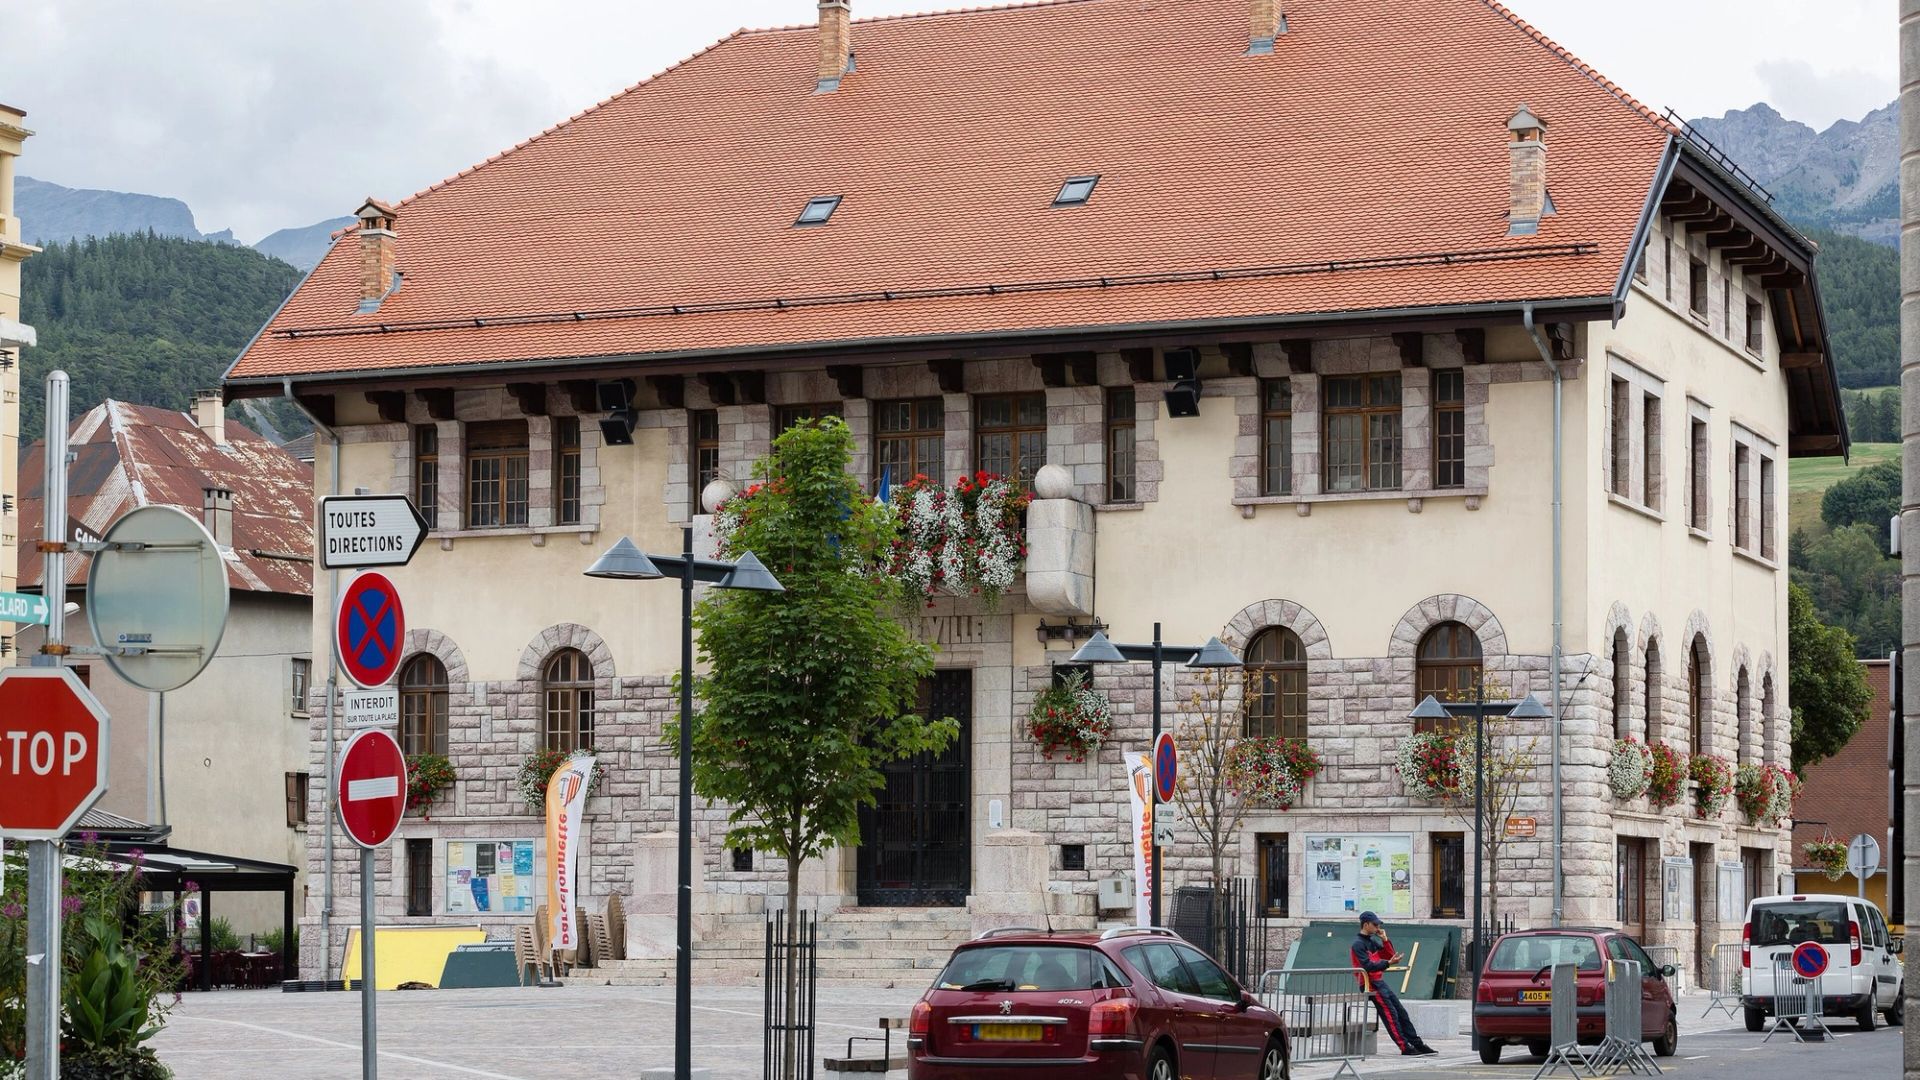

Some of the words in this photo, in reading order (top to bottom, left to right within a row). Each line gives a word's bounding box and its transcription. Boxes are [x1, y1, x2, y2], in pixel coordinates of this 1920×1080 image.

[329, 511, 376, 529] TOUTES
[329, 535, 403, 554] DIRECTIONS
[350, 696, 394, 710] INTERDIT
[347, 715, 358, 723] SUR
[358, 714, 374, 722] TOUTE
[374, 713, 382, 722] LA
[382, 712, 397, 721] PLACE
[0, 731, 88, 776] TOP
